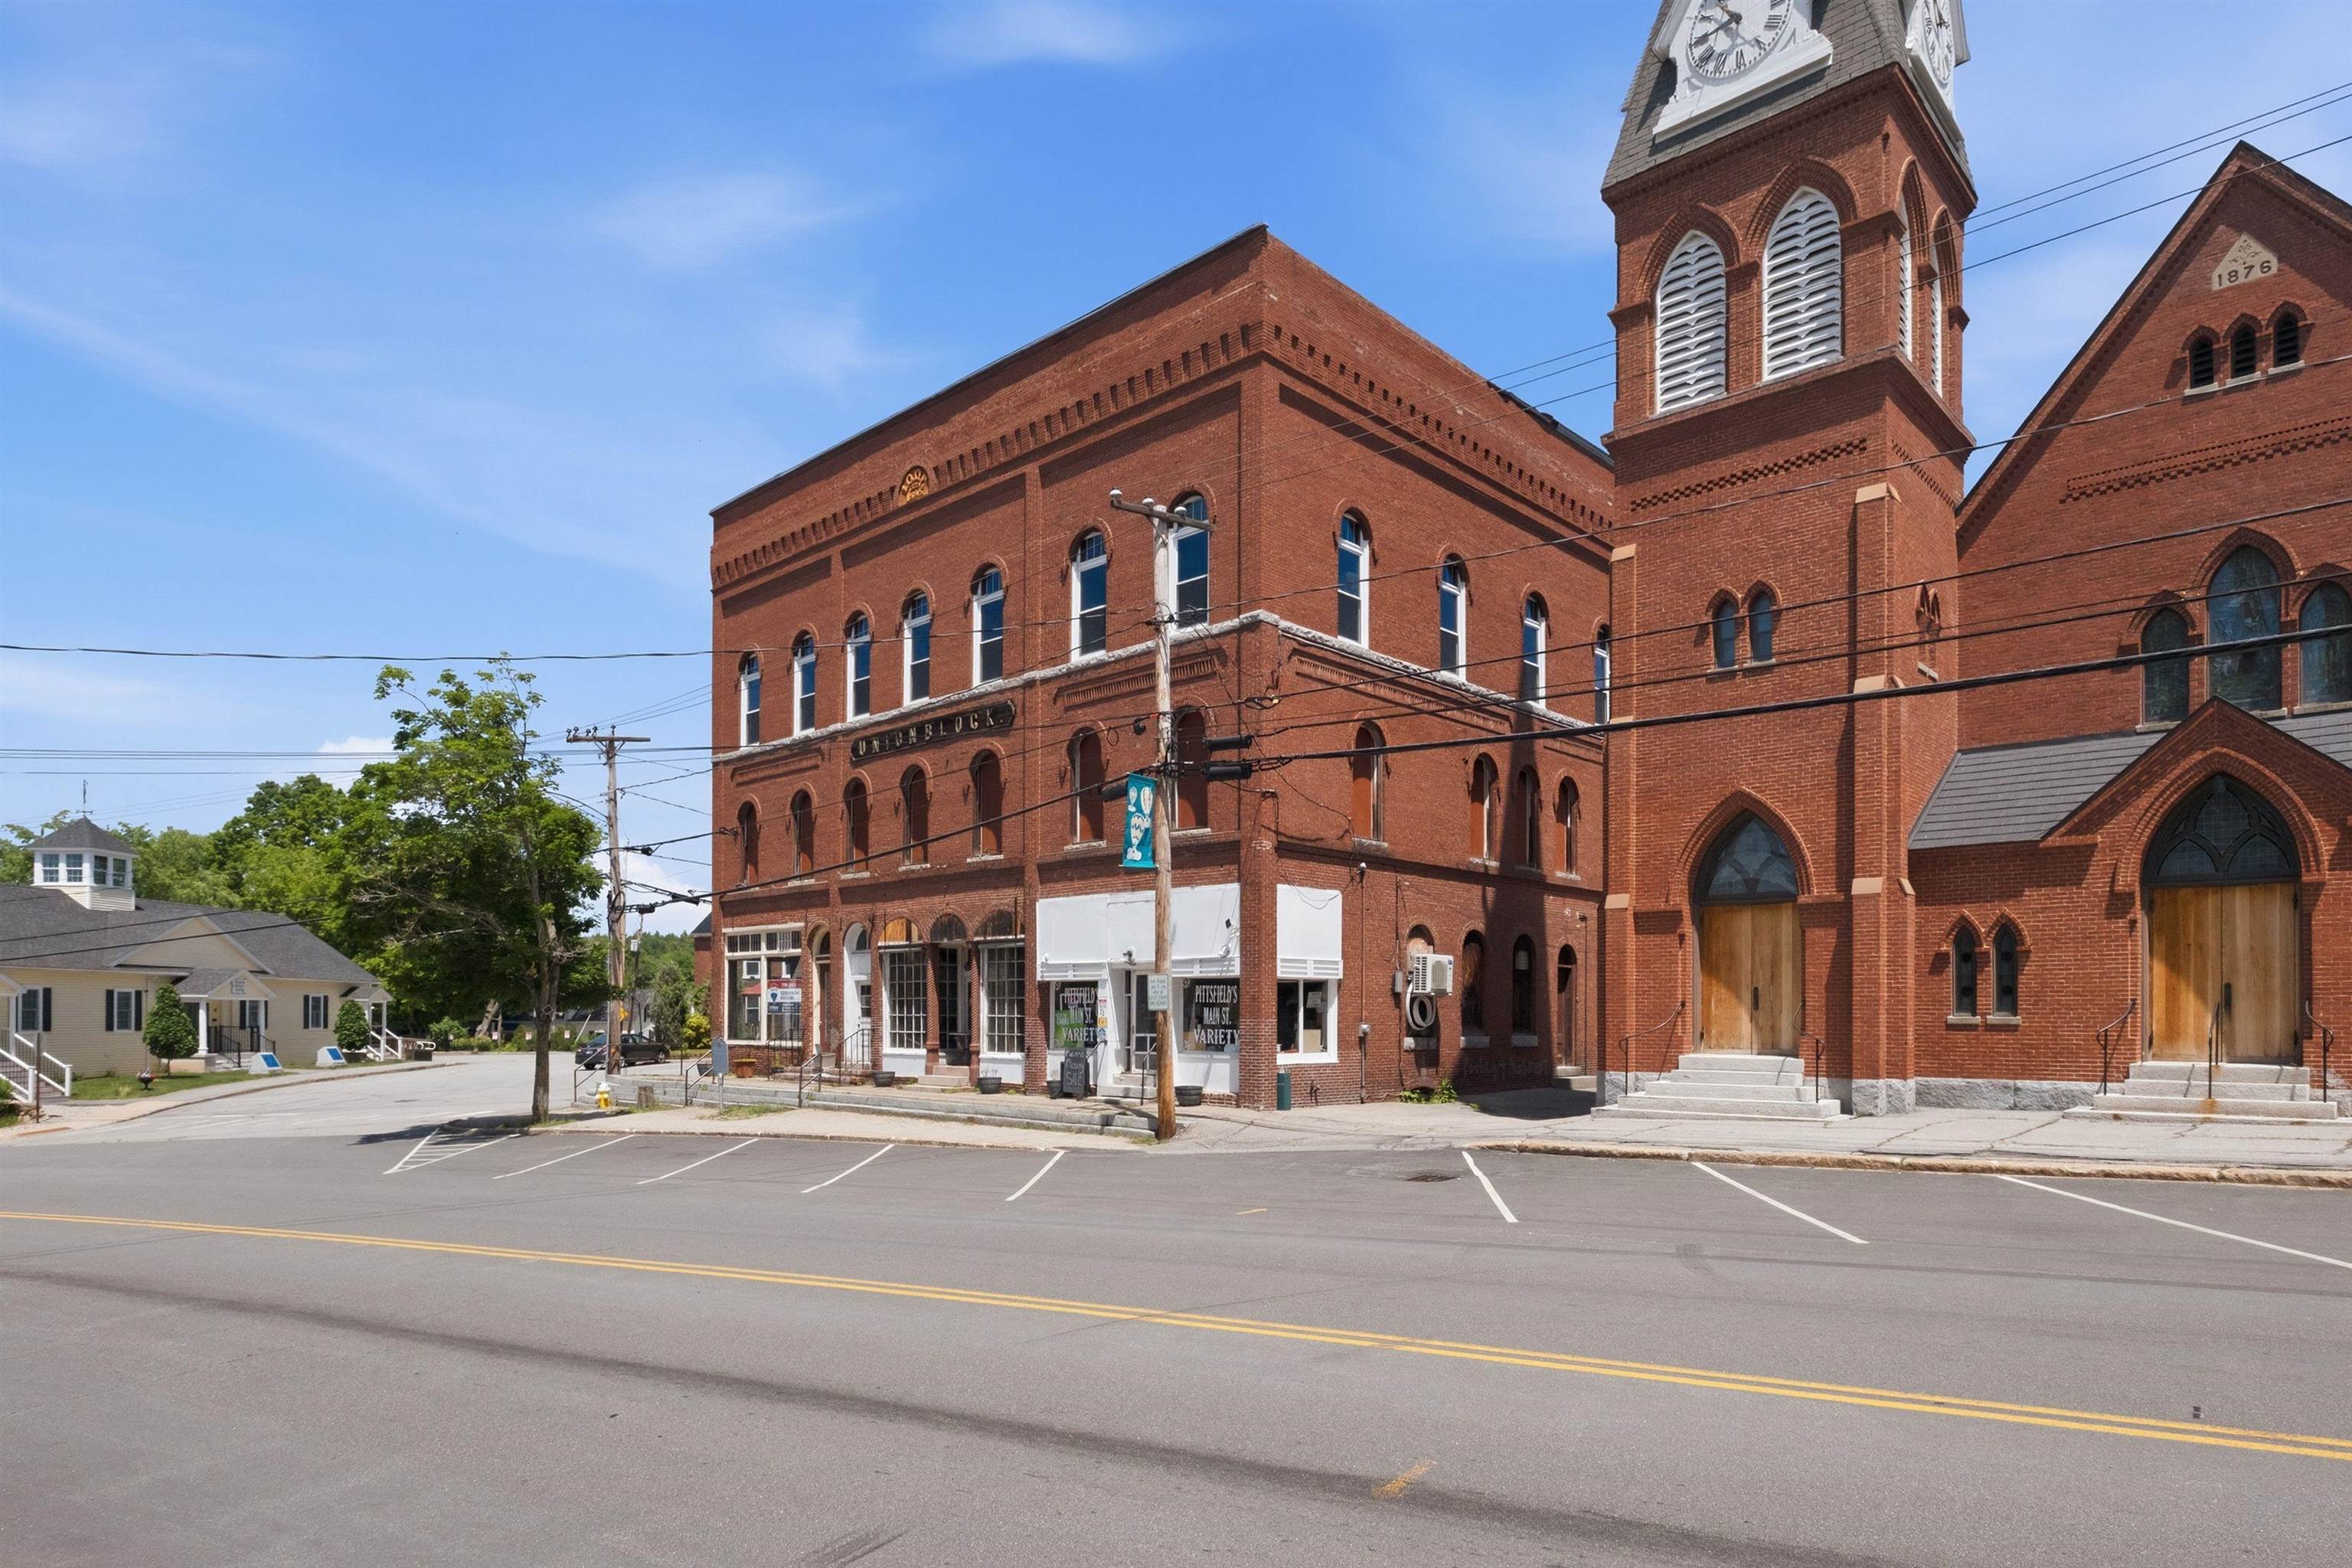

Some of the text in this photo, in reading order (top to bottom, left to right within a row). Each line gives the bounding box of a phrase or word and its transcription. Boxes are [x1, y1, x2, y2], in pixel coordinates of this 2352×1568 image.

[2217, 260, 2272, 287] 1876
[858, 727, 917, 756] UNION
[1195, 985, 1237, 1004] PITTSFIELD'S
[1203, 1007, 1232, 1025] MAIN ST.
[1194, 1028, 1240, 1045] VARIETY
